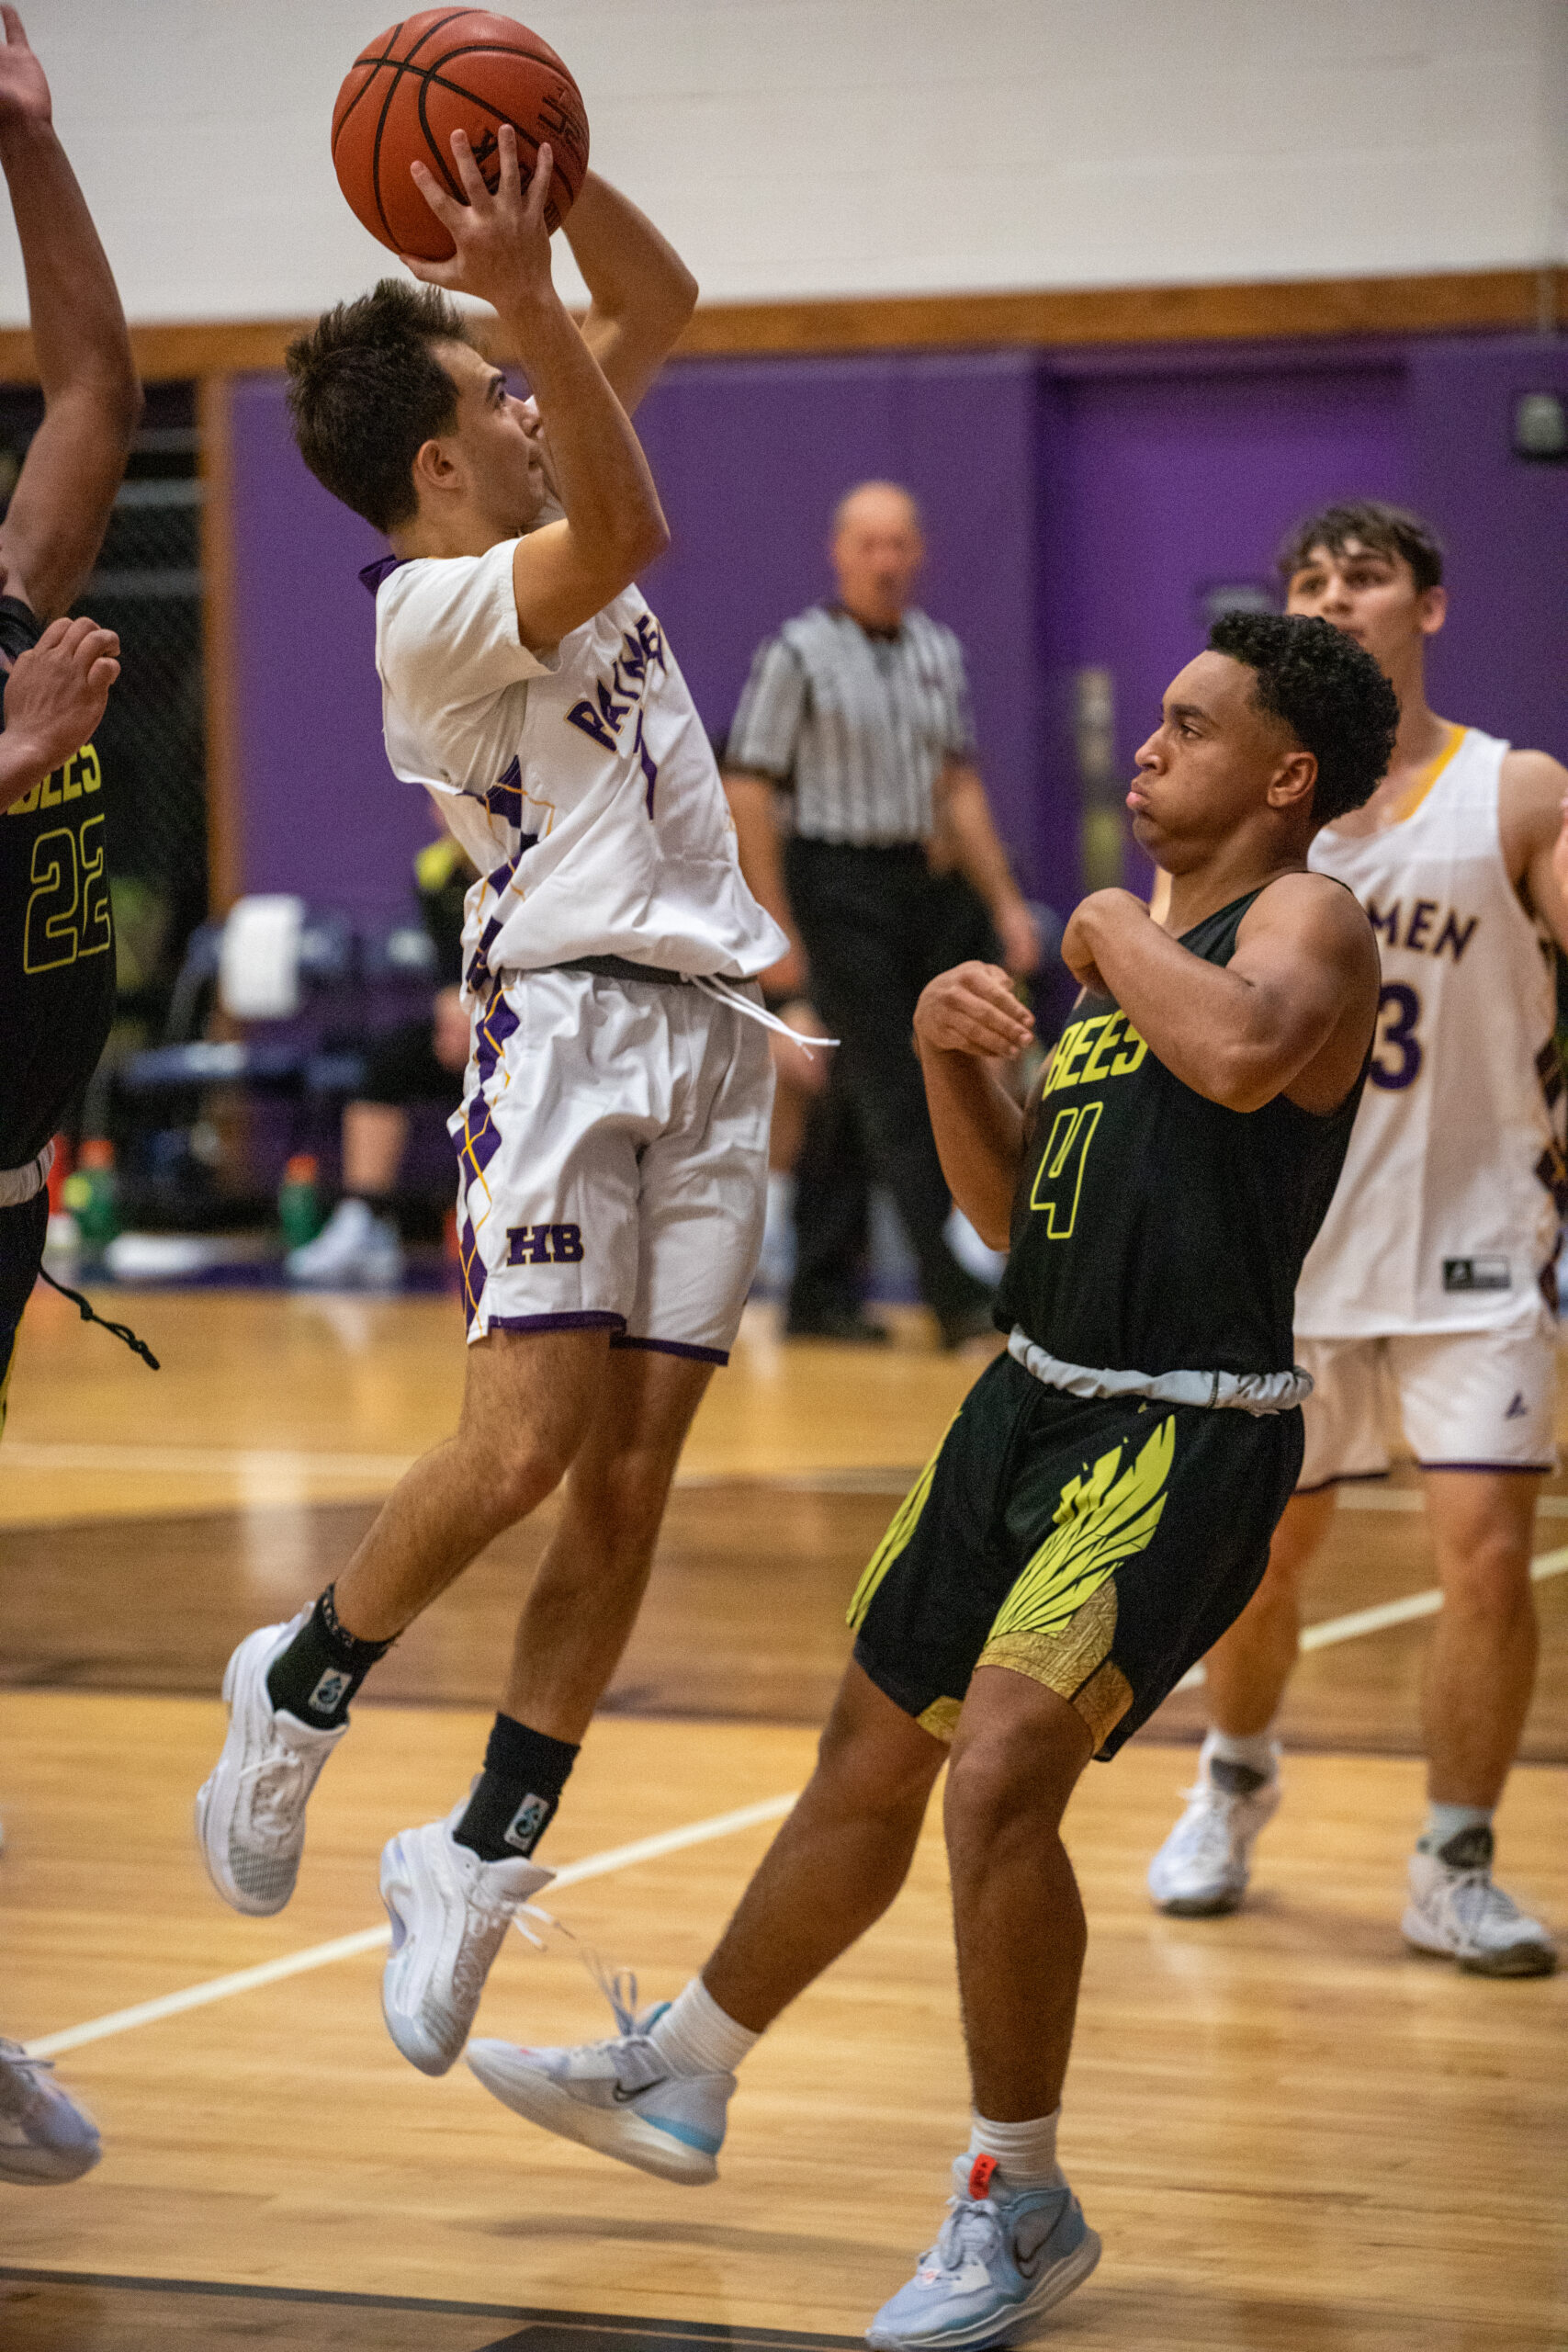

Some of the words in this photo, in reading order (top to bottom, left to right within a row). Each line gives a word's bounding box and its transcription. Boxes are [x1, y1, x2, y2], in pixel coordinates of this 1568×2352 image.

[23, 812, 111, 974] 22
[1365, 897, 1481, 964] MEN
[1041, 1009, 1149, 1102] BEES
[1030, 1101, 1104, 1239] 4
[505, 1222, 585, 1267] HB
